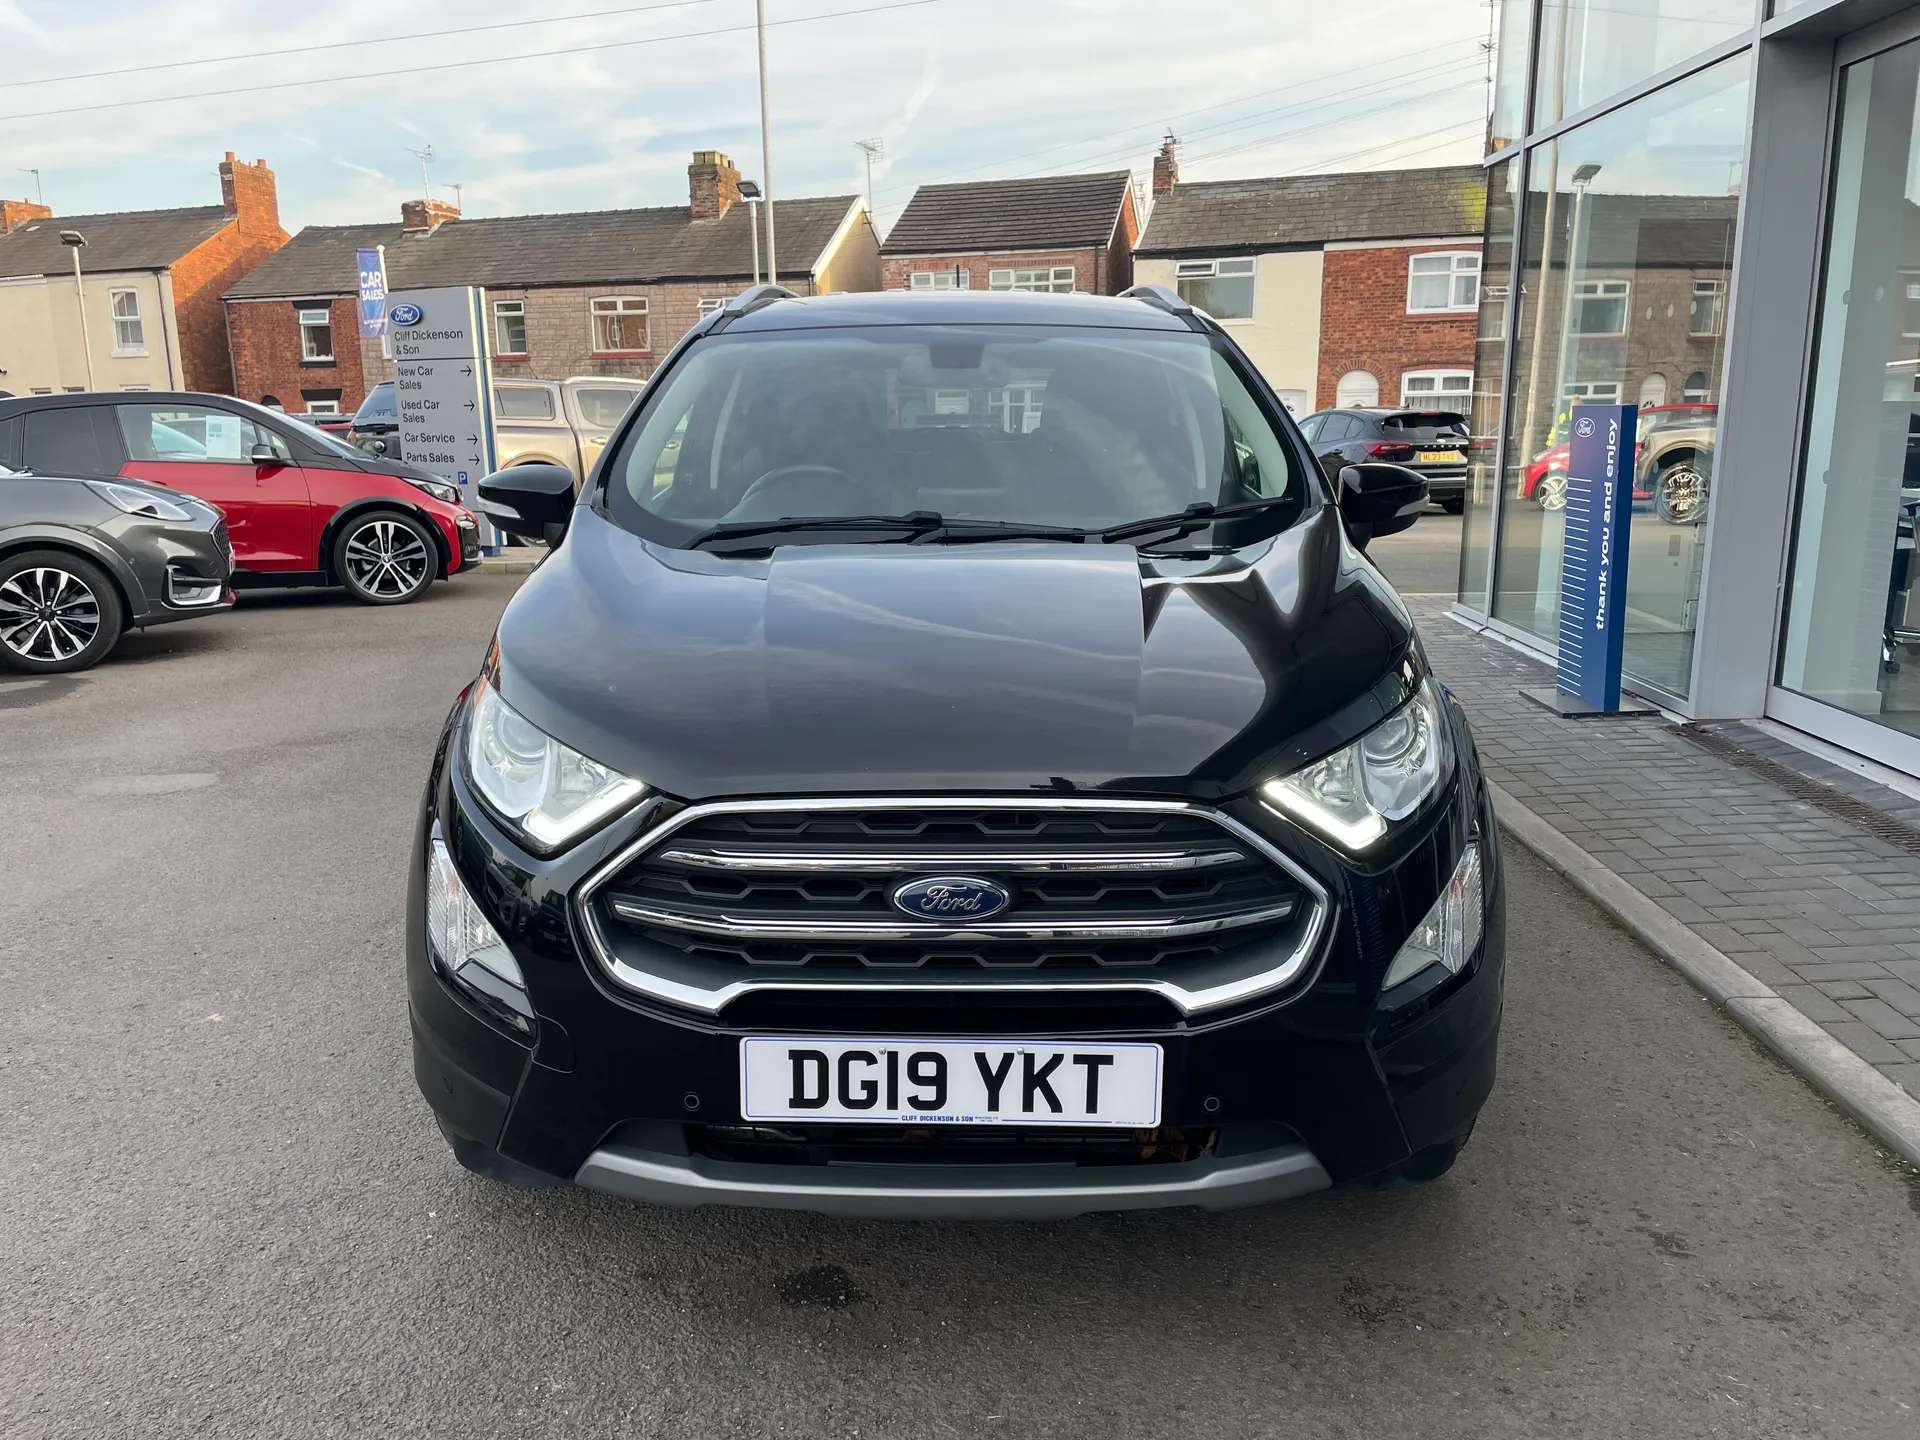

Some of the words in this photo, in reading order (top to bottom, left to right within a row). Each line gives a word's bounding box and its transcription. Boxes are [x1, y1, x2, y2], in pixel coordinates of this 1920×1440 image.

[360, 271, 382, 289] CAR
[361, 288, 384, 301] SALES
[394, 306, 415, 321] Ford
[394, 330, 411, 341] Cliff
[412, 329, 464, 341] Dickenson
[395, 344, 402, 355] &
[402, 344, 420, 355] Son
[397, 366, 416, 377] New
[417, 365, 434, 376] Car
[399, 379, 422, 390] Sales
[401, 399, 422, 410] Used
[423, 399, 440, 410] Car
[402, 412, 426, 423] Sales
[404, 432, 419, 443] Car
[419, 431, 456, 443] Service
[1605, 417, 1618, 478] enjoy
[406, 451, 428, 463] Parts
[428, 452, 456, 463] Sales
[1603, 481, 1613, 524] and
[1600, 527, 1610, 566] you
[1595, 568, 1608, 631] thank
[920, 885, 983, 911] Ford
[788, 1048, 949, 1112] DG19
[972, 1051, 1115, 1115] YKT
[901, 1114, 918, 1122] CLIFF
[919, 1114, 954, 1123] DICKENSON
[961, 1115, 974, 1123] SON
